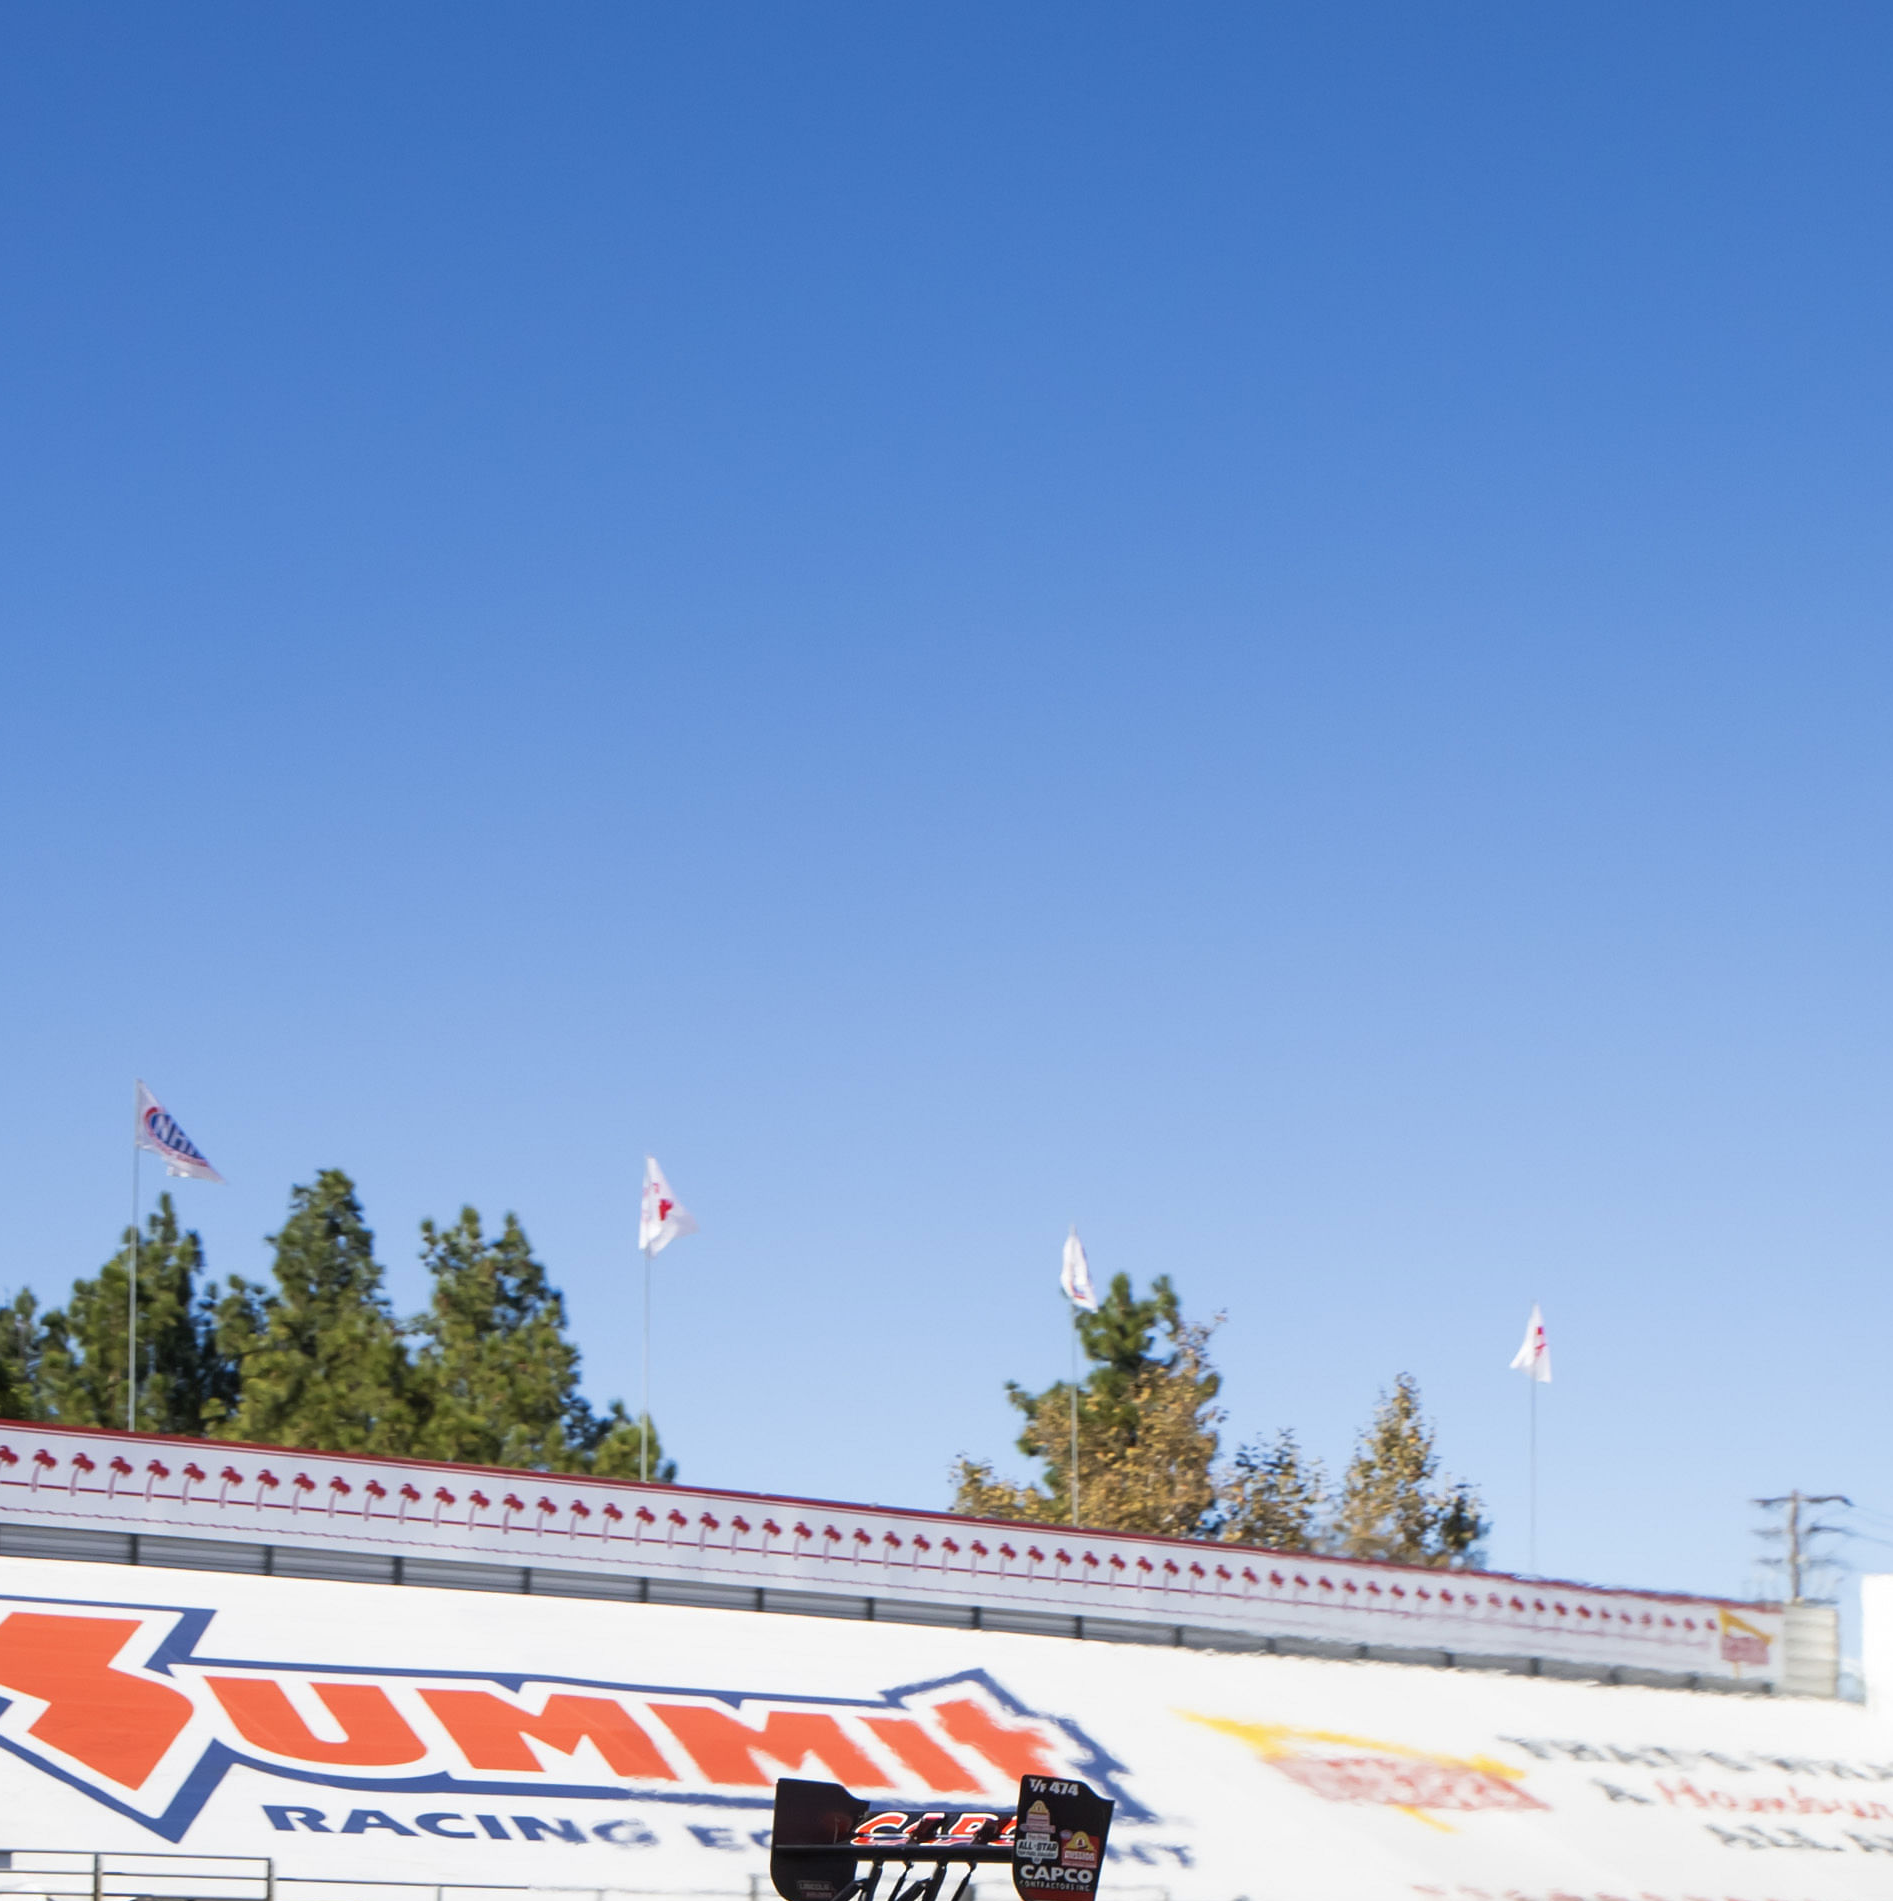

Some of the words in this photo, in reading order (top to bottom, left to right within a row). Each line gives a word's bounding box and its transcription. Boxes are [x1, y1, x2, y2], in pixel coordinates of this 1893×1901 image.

[1049, 1781, 1079, 1796] 474
[261, 1804, 659, 1847] RACING
[1020, 1864, 1093, 1883] CAPCO
